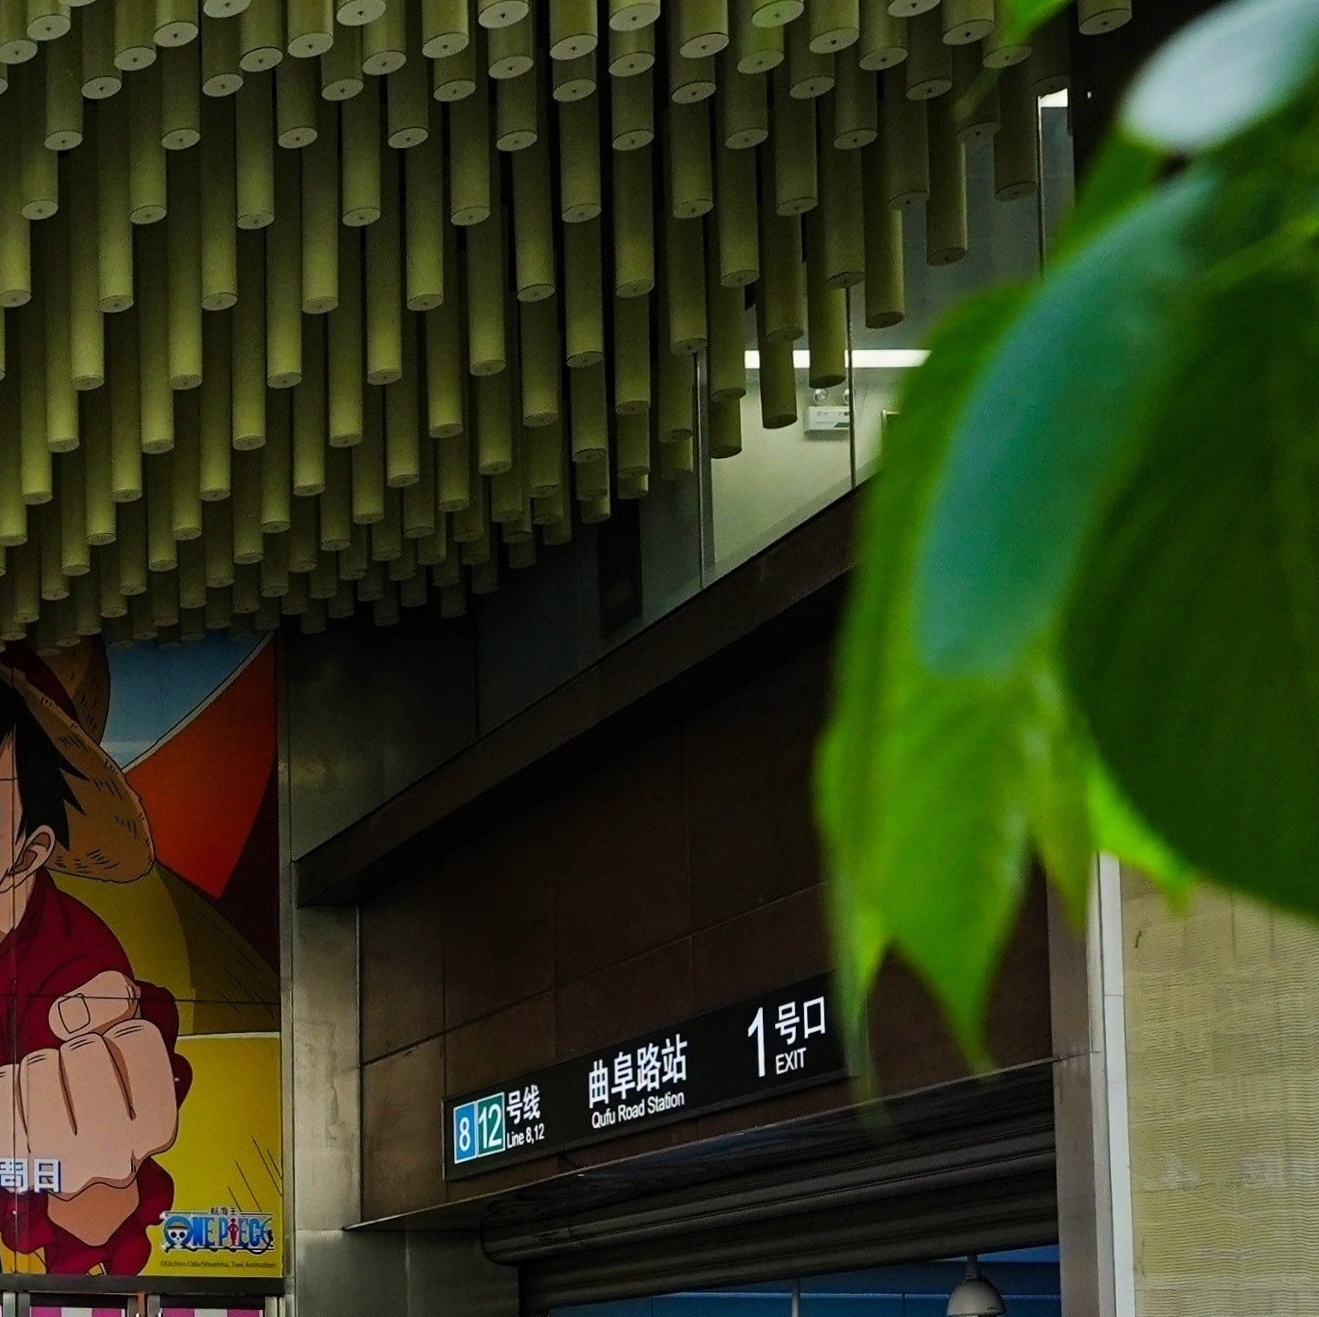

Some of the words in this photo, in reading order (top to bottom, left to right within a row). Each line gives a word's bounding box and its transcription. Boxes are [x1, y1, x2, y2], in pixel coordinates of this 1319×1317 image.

[747, 1006, 766, 1077] 1
[775, 997, 827, 1045] 号口
[588, 1034, 688, 1109] 曲阜路站
[775, 1047, 807, 1075] EXIT
[459, 1116, 471, 1152] 8
[478, 1103, 503, 1149] 12
[506, 1085, 541, 1126] 号线
[591, 1107, 616, 1130] Qufu
[617, 1100, 646, 1122] Road
[647, 1091, 685, 1116] Station
[507, 1129, 524, 1149] Line
[219, 1216, 274, 1248] PIECE
